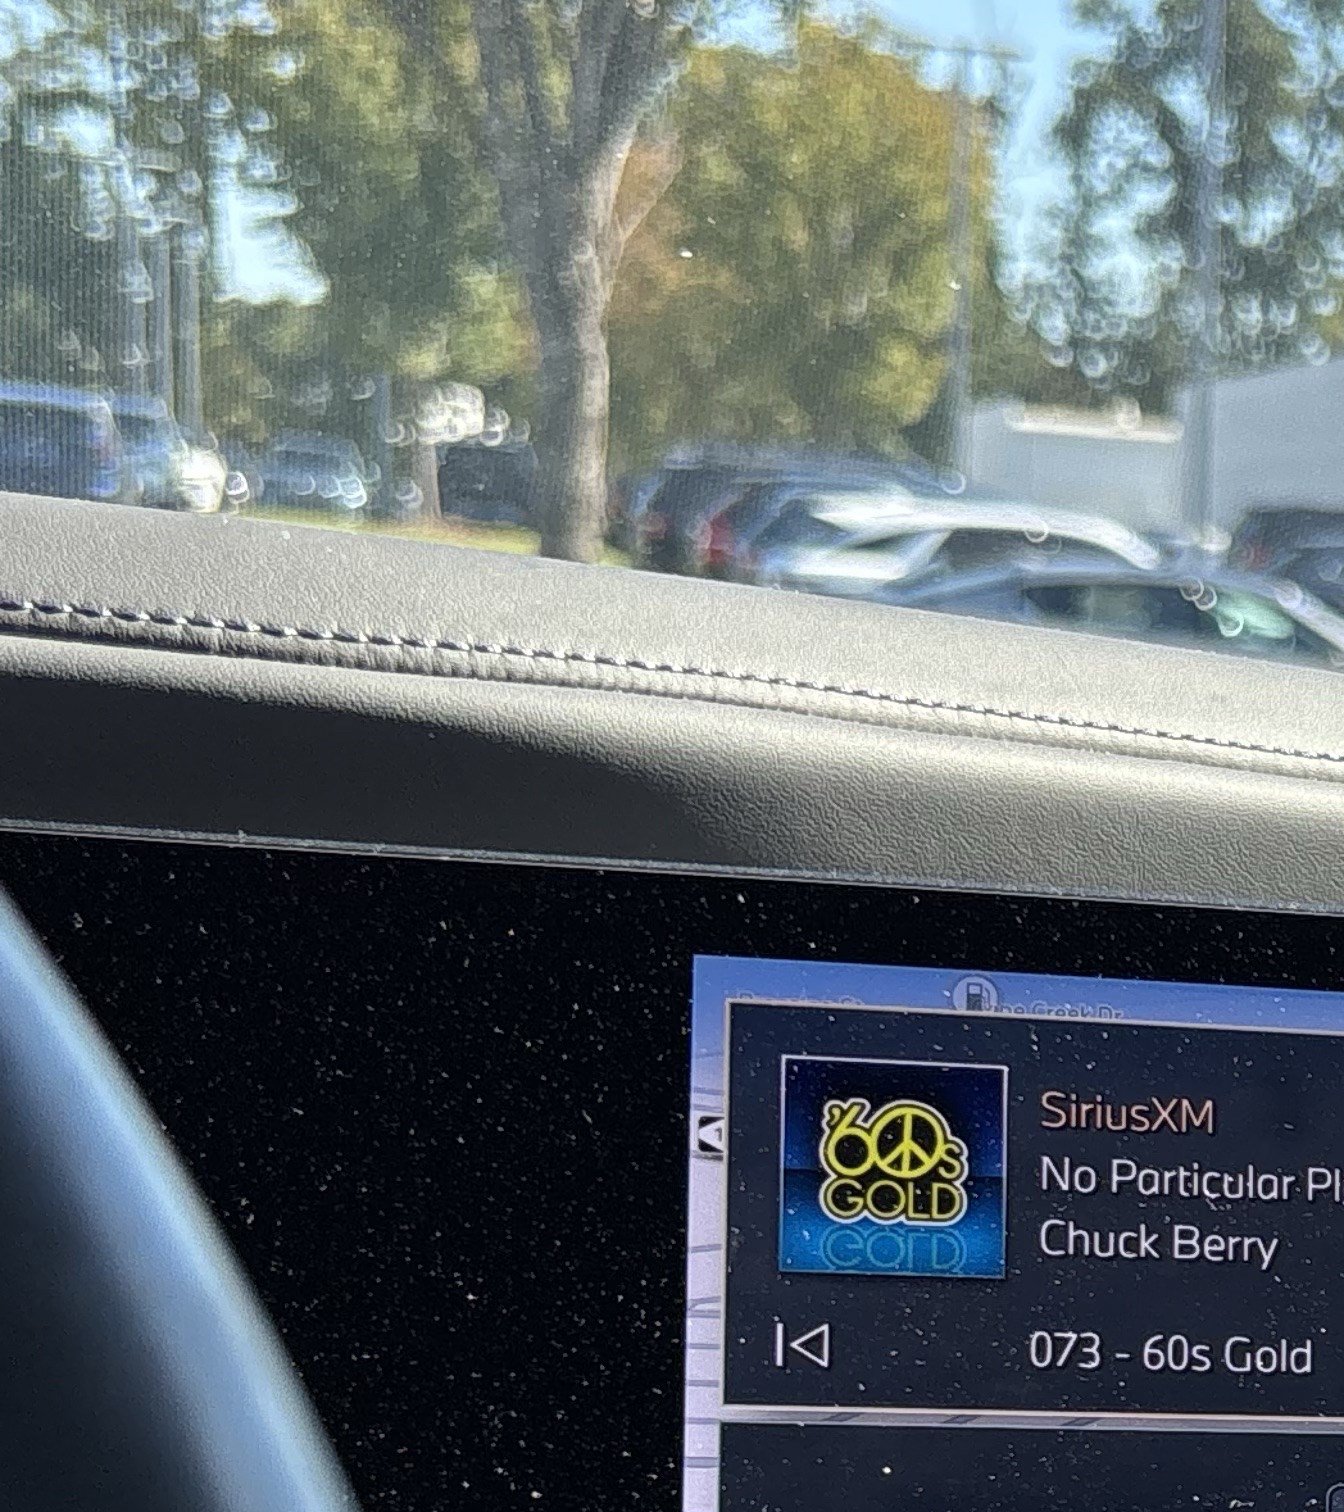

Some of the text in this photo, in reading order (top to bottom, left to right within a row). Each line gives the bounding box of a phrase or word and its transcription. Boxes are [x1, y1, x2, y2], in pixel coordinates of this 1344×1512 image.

[1040, 1091, 1215, 1135] SiriusXM
[825, 1178, 962, 1221] GOLD
[1040, 1155, 1097, 1195] No
[1111, 1158, 1297, 1201] Particular
[1040, 1219, 1279, 1270] Chuck Berry
[1029, 1330, 1102, 1369] 073
[1143, 1334, 1212, 1372] 60s
[1224, 1336, 1312, 1374] Gold
